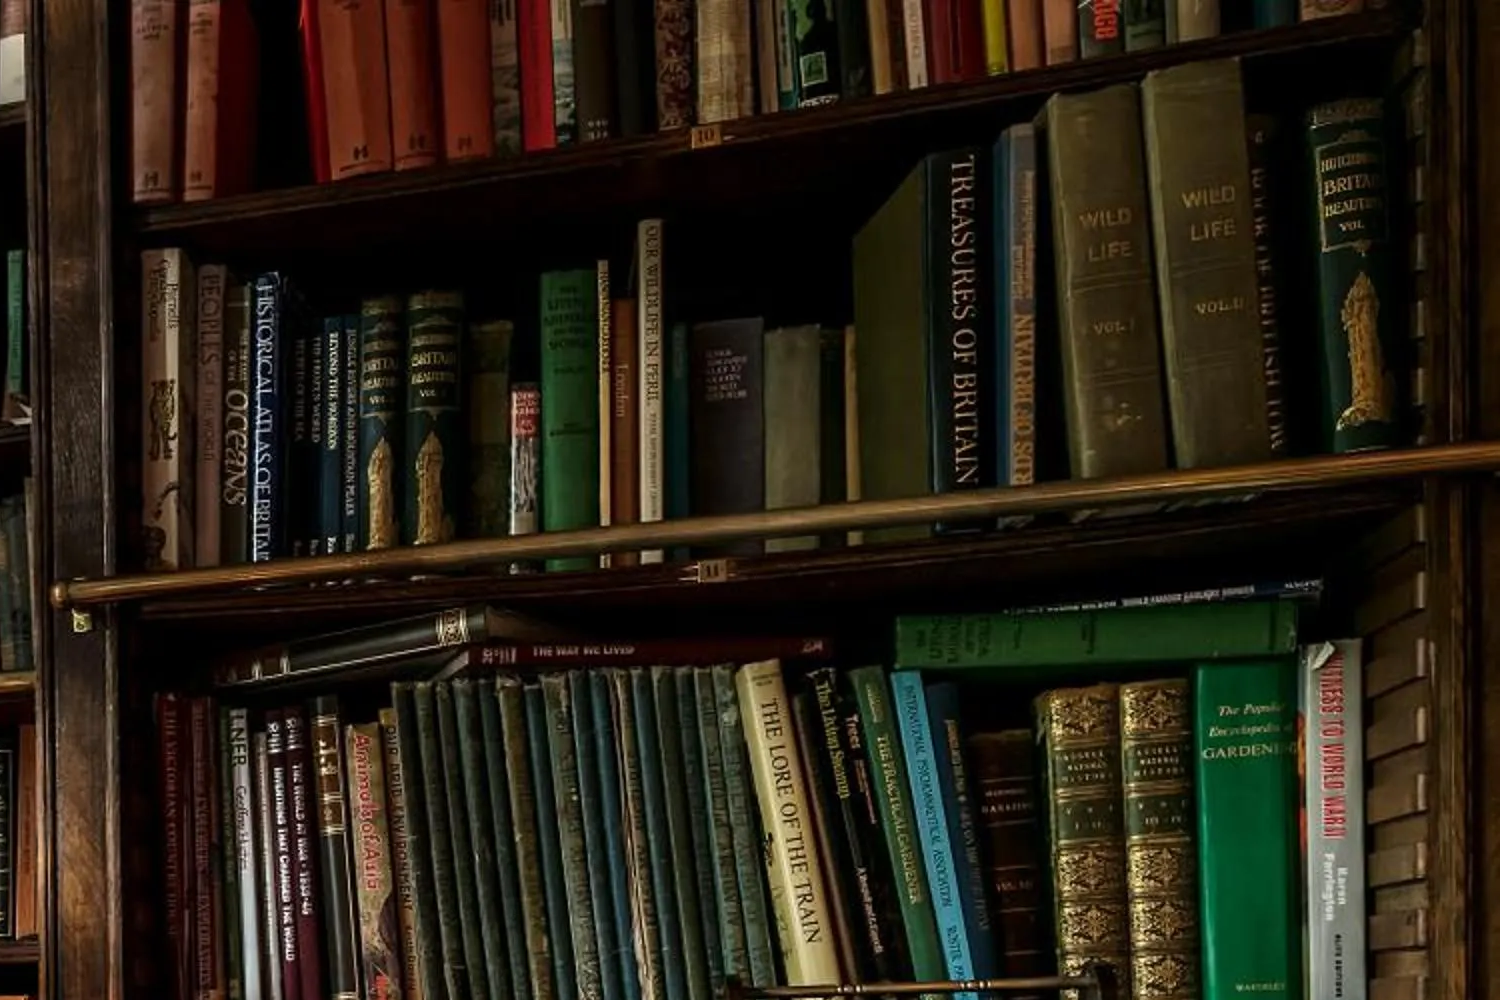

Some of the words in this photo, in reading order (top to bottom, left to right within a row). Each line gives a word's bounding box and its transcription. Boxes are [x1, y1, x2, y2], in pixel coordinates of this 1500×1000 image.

[1180, 185, 1236, 209] WILD
[951, 154, 978, 321] TREASURES
[1078, 207, 1133, 230] WILD
[1189, 218, 1237, 242] LIFE
[646, 226, 659, 258] OUR
[1087, 241, 1134, 263] LIFE
[200, 274, 220, 366] PEOPLES
[646, 264, 659, 338] WILDLIFE
[255, 285, 274, 394] HISTORICAL
[328, 331, 340, 375] BEYOND
[646, 340, 659, 359] IN
[953, 327, 978, 366] OF
[1012, 313, 1034, 401] BRITAIN
[615, 363, 629, 418] London
[647, 363, 659, 405] PERIL
[255, 407, 273, 463] ATLAS
[953, 372, 980, 484] BRITAIN
[255, 467, 272, 495] OF
[816, 681, 836, 707] The
[1218, 704, 1239, 717] The
[761, 699, 783, 738] THE
[822, 710, 844, 752] Living
[1321, 719, 1345, 739] TO
[230, 714, 247, 767] LNER
[876, 734, 893, 761] THE
[291, 763, 303, 782] THE
[354, 734, 378, 820] Animals
[768, 745, 792, 796] LORE
[831, 754, 853, 800] Swamp
[1321, 744, 1346, 791] WORLD
[293, 784, 306, 820] WORLD
[778, 803, 799, 829] OF
[881, 762, 906, 833] PRACTICAL
[903, 685, 926, 756] INTERNATIONAL
[931, 849, 955, 907] ASSOCIATION
[1322, 797, 1346, 827] WAR
[296, 823, 307, 836] AT
[362, 823, 382, 845] of
[385, 726, 398, 756] OUR
[392, 806, 414, 912] ENVIRONMENT
[276, 828, 288, 853] THAT
[297, 838, 308, 862] WAR
[784, 831, 809, 875] THE
[278, 855, 291, 903] CHANGED
[364, 848, 386, 891] Asia
[895, 834, 920, 906] GARDENER
[1322, 853, 1337, 922] Farrington
[1337, 867, 1349, 906] Karen
[281, 906, 293, 924] THE
[790, 880, 822, 945] TRAIN
[282, 926, 295, 962] WORLD
